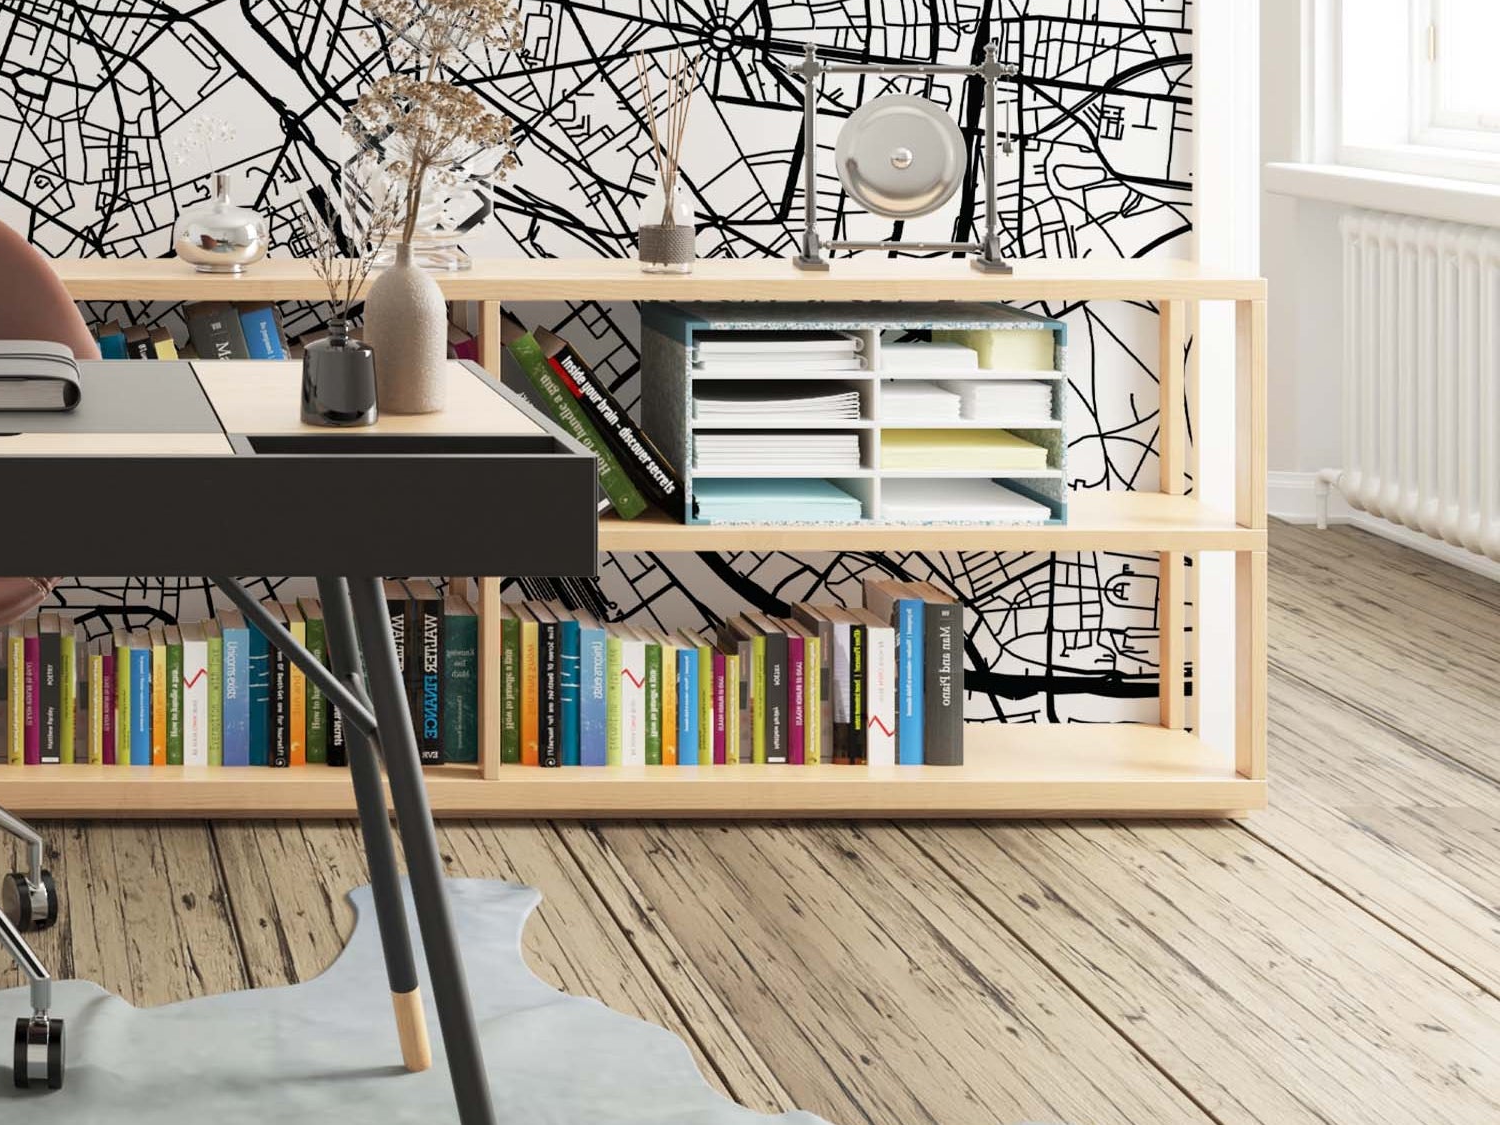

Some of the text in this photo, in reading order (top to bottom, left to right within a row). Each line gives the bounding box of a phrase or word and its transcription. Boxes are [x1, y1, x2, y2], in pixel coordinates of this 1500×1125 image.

[554, 394, 563, 403] a
[559, 403, 586, 440] handle
[561, 355, 676, 495] Inside your brain discover secrets
[227, 641, 237, 699] Unicorns exists
[313, 701, 320, 710] to
[334, 721, 343, 746] secrets
